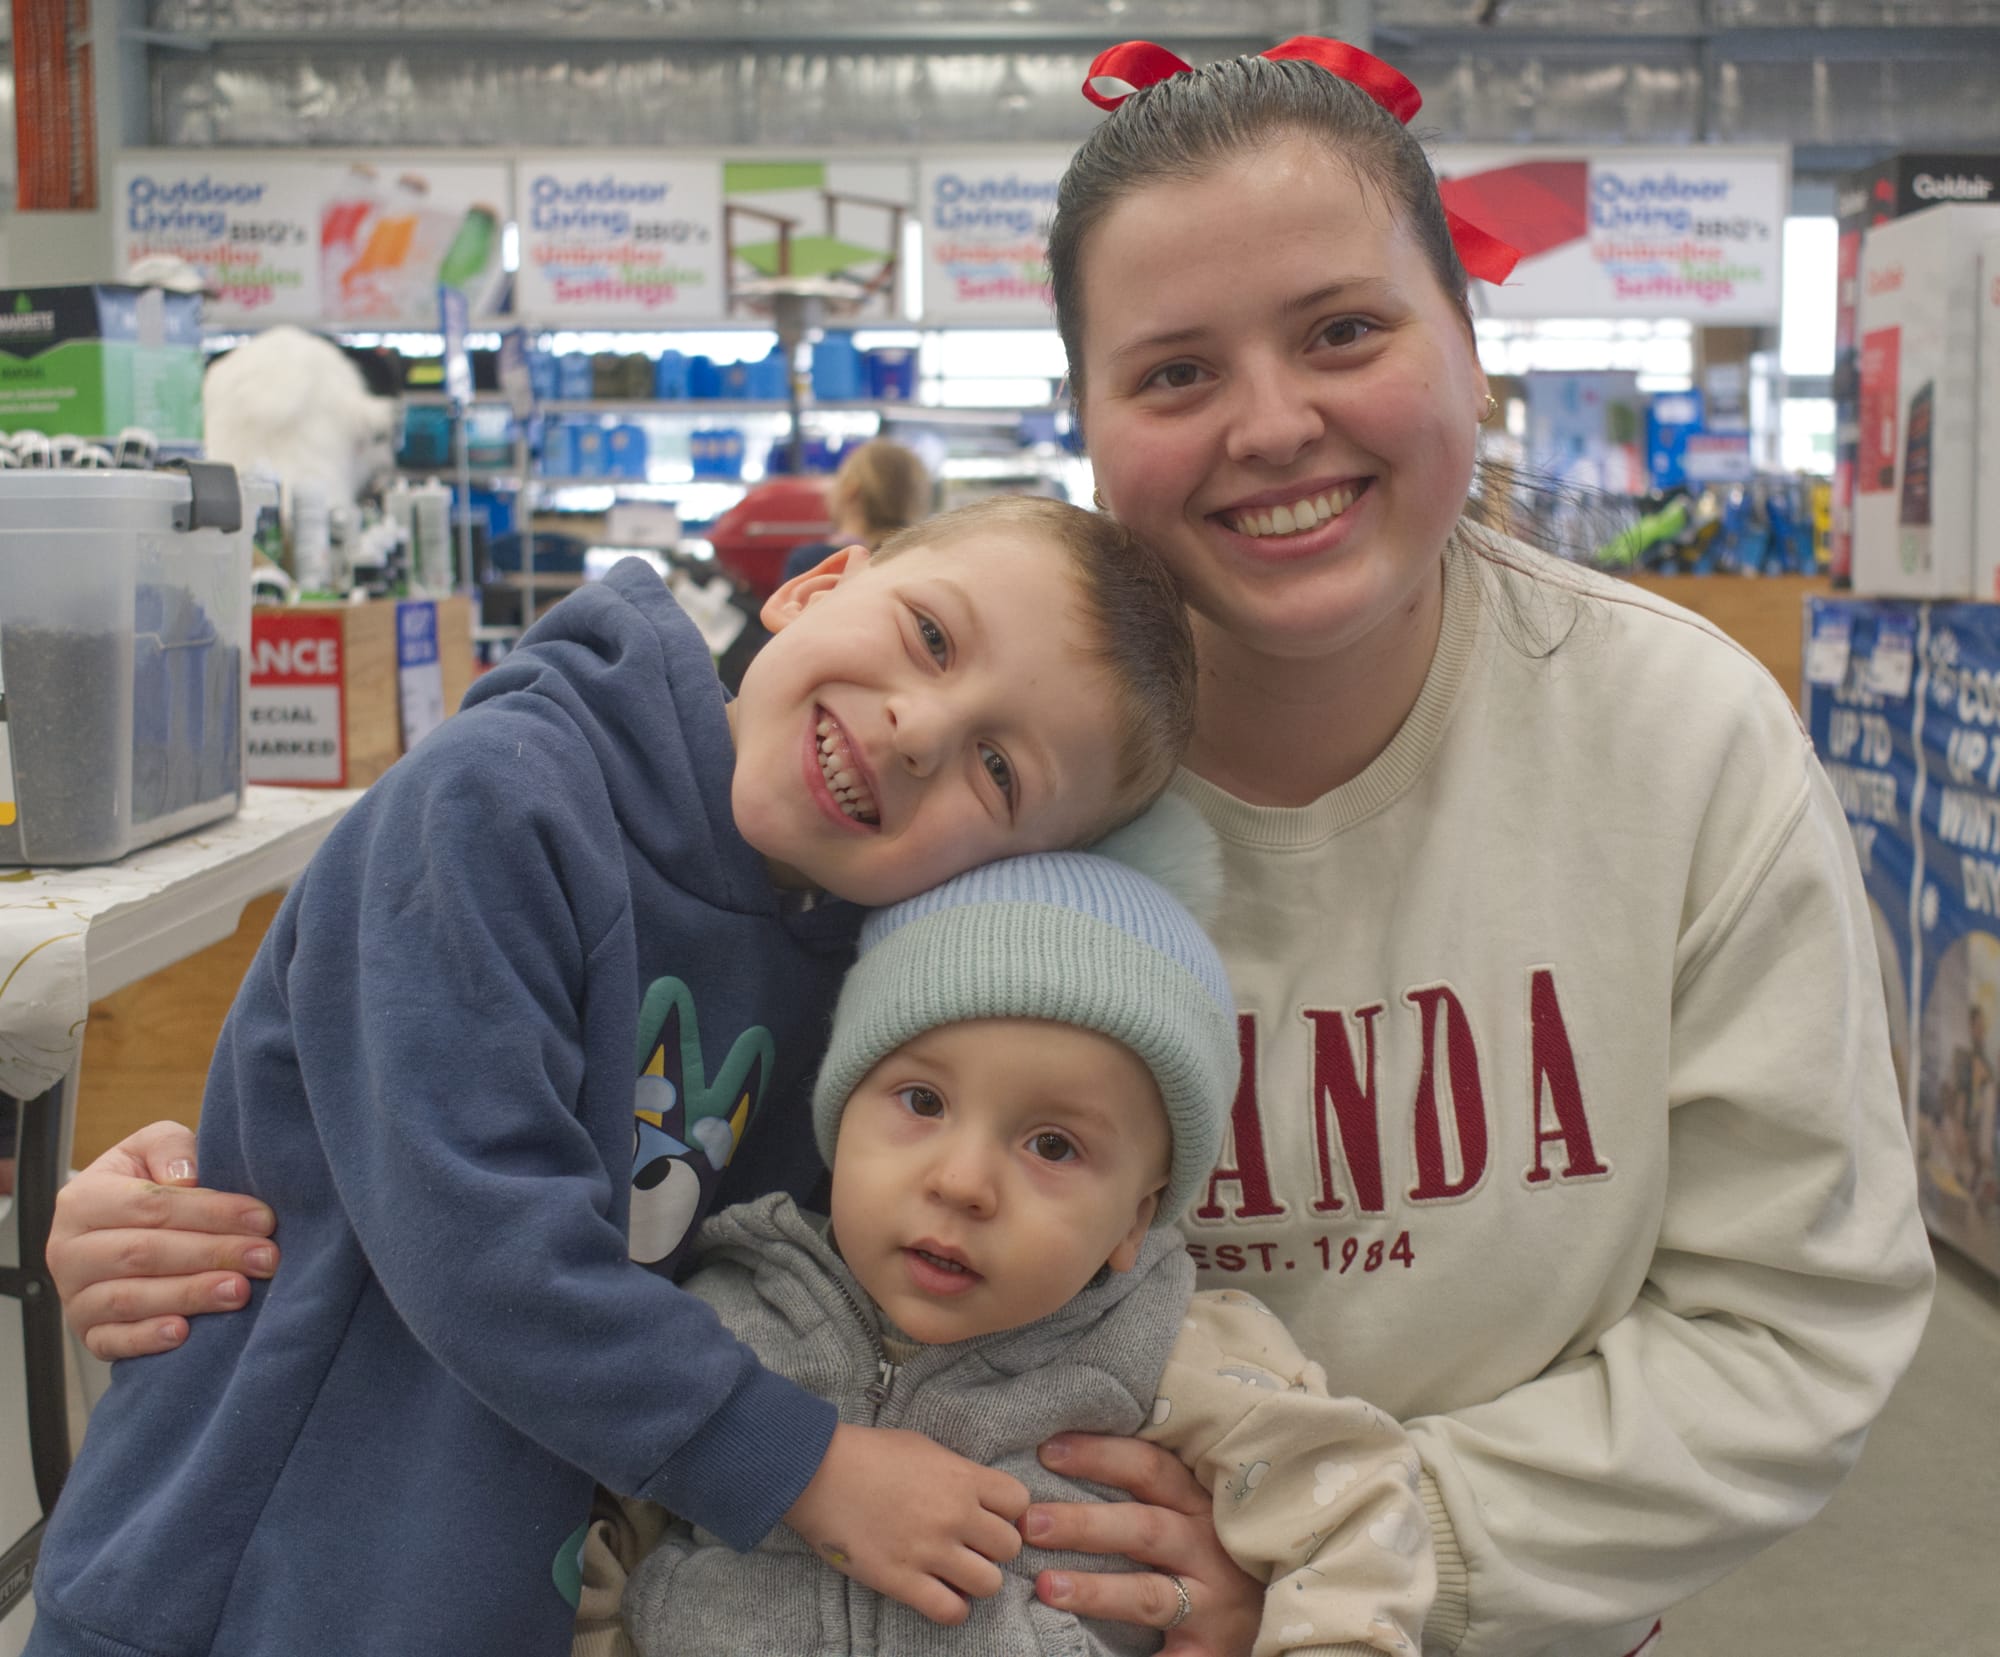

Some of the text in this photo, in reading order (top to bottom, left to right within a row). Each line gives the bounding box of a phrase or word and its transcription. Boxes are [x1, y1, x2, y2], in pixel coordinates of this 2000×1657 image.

[128, 174, 265, 204] Outdoor
[531, 173, 670, 204] Outdoor
[933, 172, 1059, 204] Outdoo
[1593, 172, 1731, 202] Outdoor
[128, 203, 225, 237] Living
[531, 203, 630, 236] Living
[933, 203, 1033, 236] Living
[1592, 201, 1691, 234] Living
[956, 277, 1054, 310] Setting
[1186, 1230, 1416, 1275] EST. 1984
